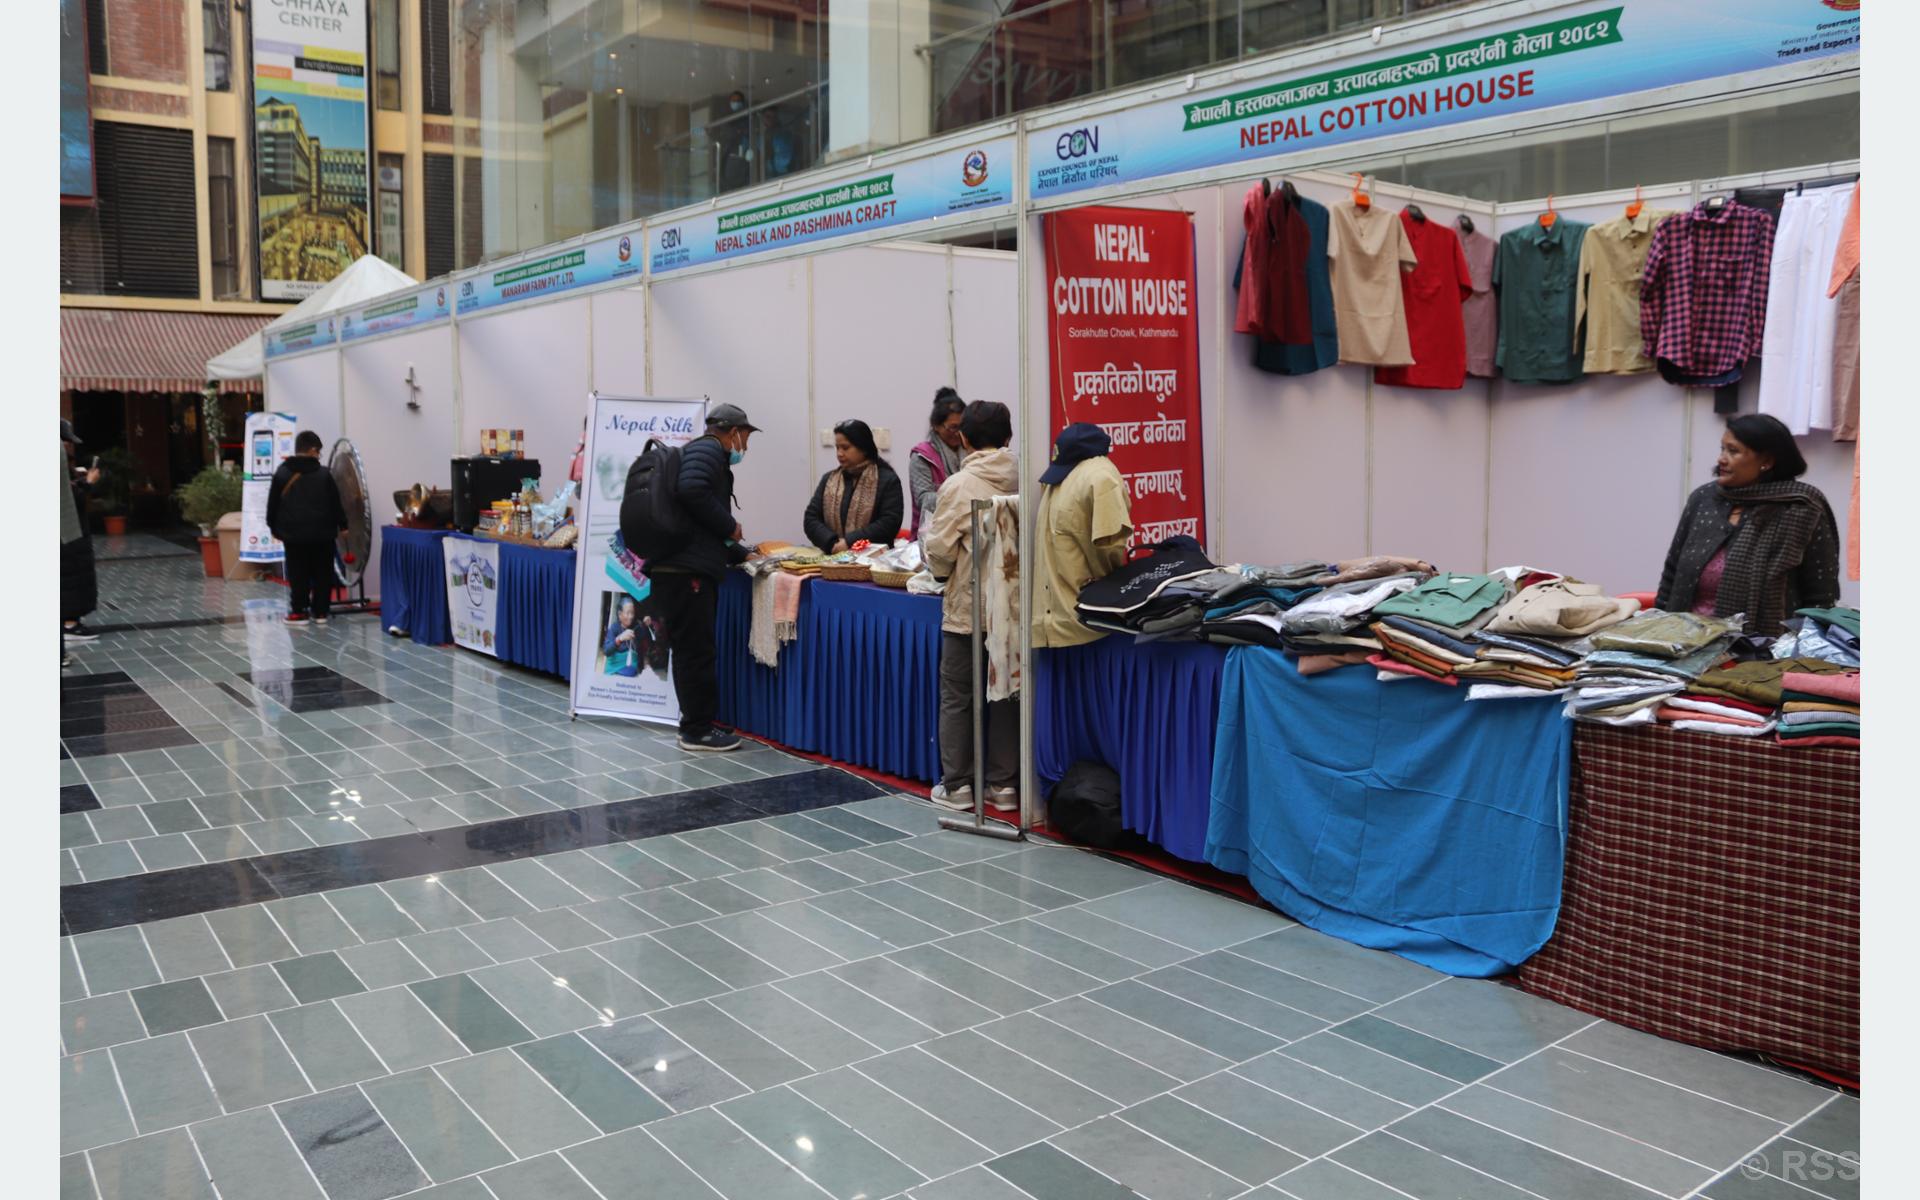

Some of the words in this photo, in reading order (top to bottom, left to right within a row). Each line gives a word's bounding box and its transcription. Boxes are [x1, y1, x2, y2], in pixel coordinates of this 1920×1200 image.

[278, 10, 343, 32] CENTER
[1777, 47, 1801, 58] Trade
[1803, 43, 1820, 53] and
[1823, 36, 1853, 49] Export
[1190, 99, 1231, 124] नेपाली
[1446, 40, 1507, 73] प्रदर्शनी
[1513, 31, 1553, 56] मेला
[1559, 20, 1609, 46] २०८२
[1240, 115, 1313, 149] NEPAL
[1319, 91, 1427, 134] COTTON
[1434, 70, 1534, 113] HOUSE
[1098, 155, 1119, 165] NEPAL
[715, 237, 745, 254] NEPAL
[746, 230, 767, 247] SILK
[769, 223, 792, 242] AND
[794, 209, 853, 237] PASHMINA
[856, 199, 897, 224] CRAFT
[1094, 223, 1150, 263] NEPAL
[1054, 276, 1127, 315] COTTON
[1131, 278, 1187, 316] HOUSE
[1068, 327, 1109, 338] Sorakhutte
[1110, 327, 1137, 339] Chowk,
[1139, 328, 1179, 338] Kathmandu
[1073, 361, 1143, 406] प्रकृतिको
[1144, 369, 1177, 403] फुल
[605, 414, 657, 436] Nepal
[660, 416, 694, 433] Silk
[1142, 411, 1186, 444] बनेका
